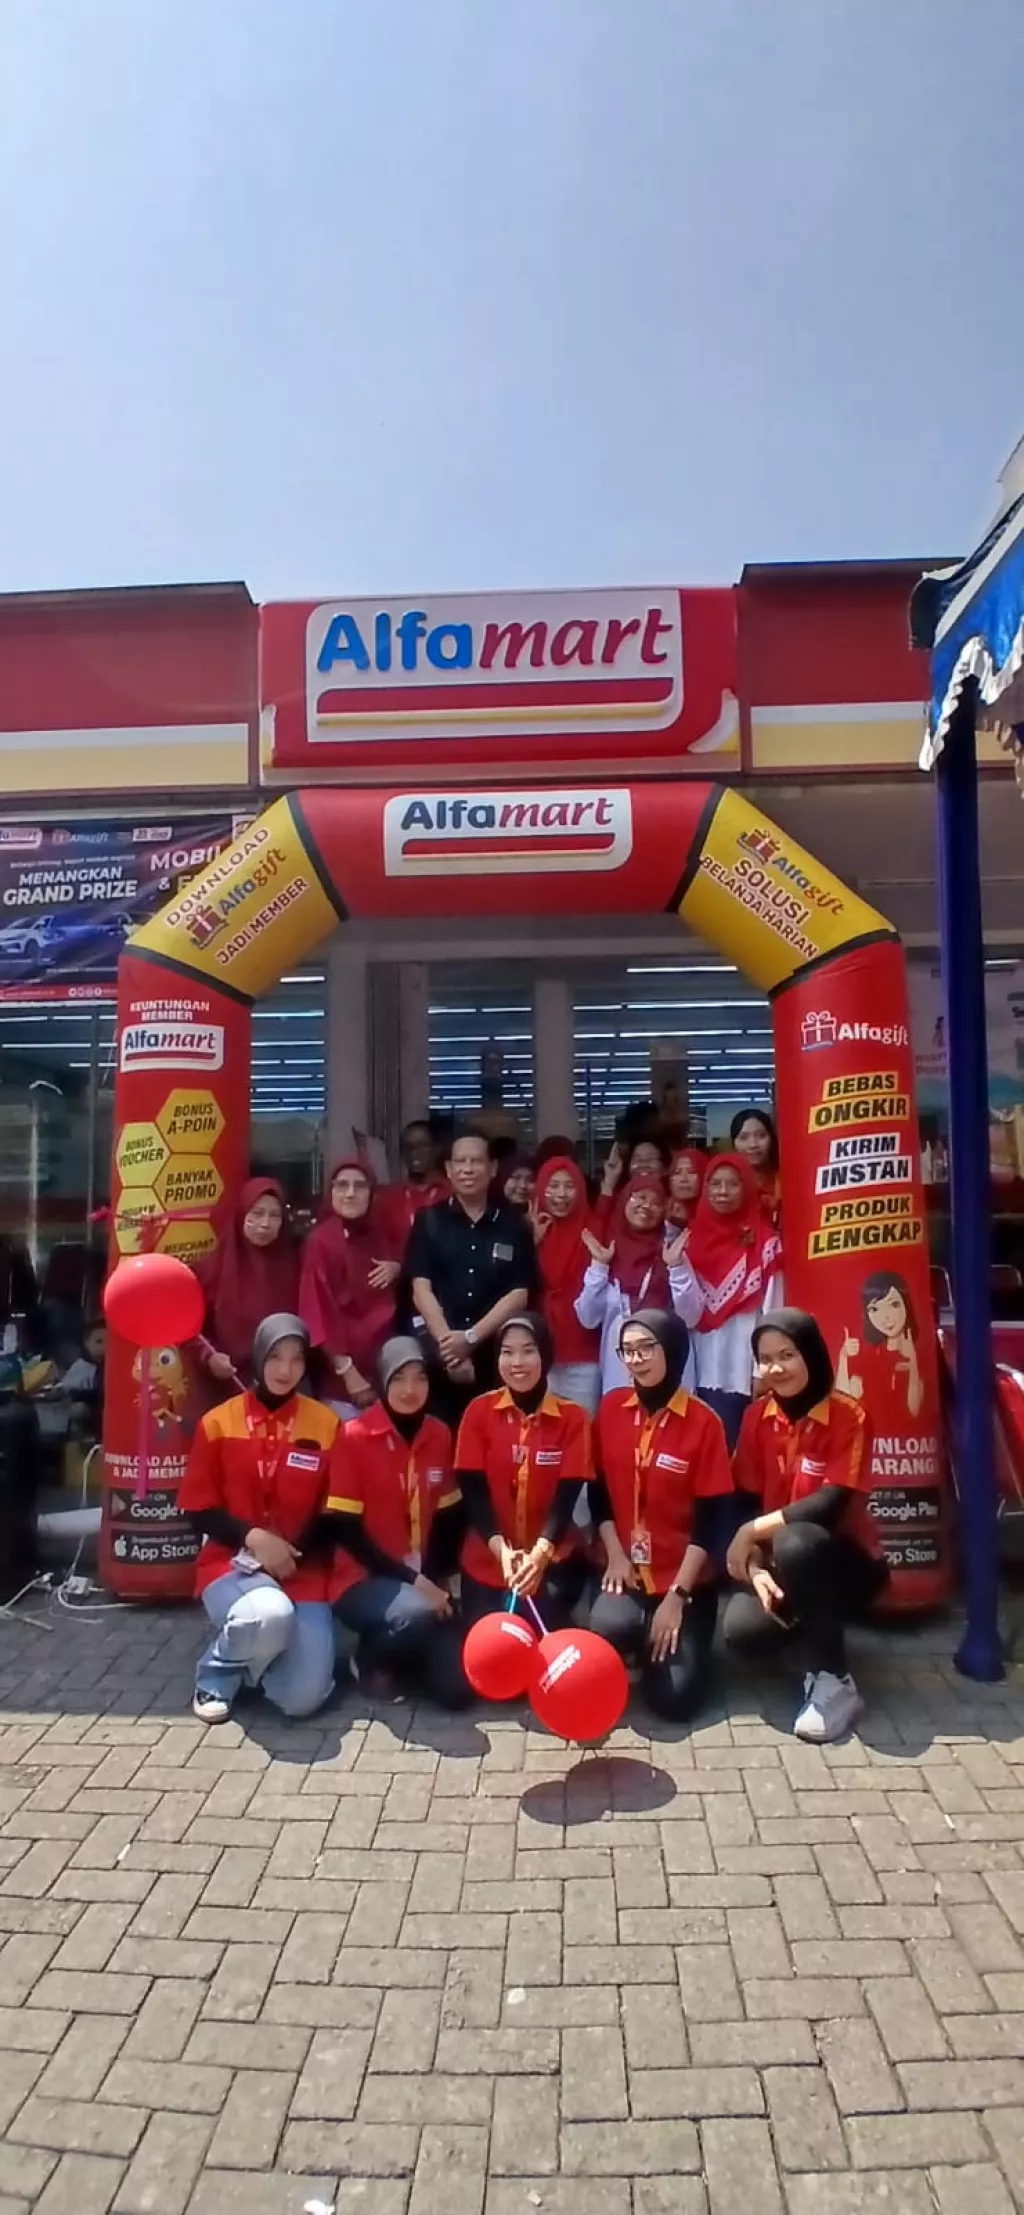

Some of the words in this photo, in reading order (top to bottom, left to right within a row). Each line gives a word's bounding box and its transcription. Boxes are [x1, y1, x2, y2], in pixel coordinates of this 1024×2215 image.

[316, 608, 674, 672] Alfamart
[401, 797, 613, 830] Alfamart
[18, 866, 123, 886] MENANGKAN
[167, 829, 269, 925] DOWNLOAD
[219, 848, 286, 916] Alfagift
[772, 856, 844, 915] Alfagift
[3, 884, 75, 905] GRAND
[79, 880, 138, 900] PRIZE
[734, 859, 810, 925] SOLUSI
[700, 856, 762, 915] BELANJA
[762, 909, 818, 958] HARIAN
[216, 928, 252, 964] JADI
[249, 878, 307, 934] MEMBER
[129, 1000, 210, 1012] KEUNTUNGAN
[141, 1011, 193, 1021] MEMBER
[125, 1030, 217, 1050] Alfamart
[838, 1022, 908, 1047] Alfagift
[827, 1074, 896, 1097] BEBAS
[173, 1103, 214, 1118] BONUS
[814, 1098, 907, 1127] ONGKIR
[167, 1117, 217, 1135] A-POIN
[125, 1137, 154, 1152] BONUS
[835, 1135, 897, 1158] KIRIM
[166, 1169, 214, 1186] BANYAK
[820, 1158, 910, 1189] INSTAN
[165, 1184, 217, 1203] PROMO
[824, 1196, 911, 1223] PRODUK
[812, 1220, 921, 1255] LENGKAP
[130, 1503, 178, 1520] Google
[130, 1545, 159, 1561] App
[162, 1543, 199, 1557] Store
